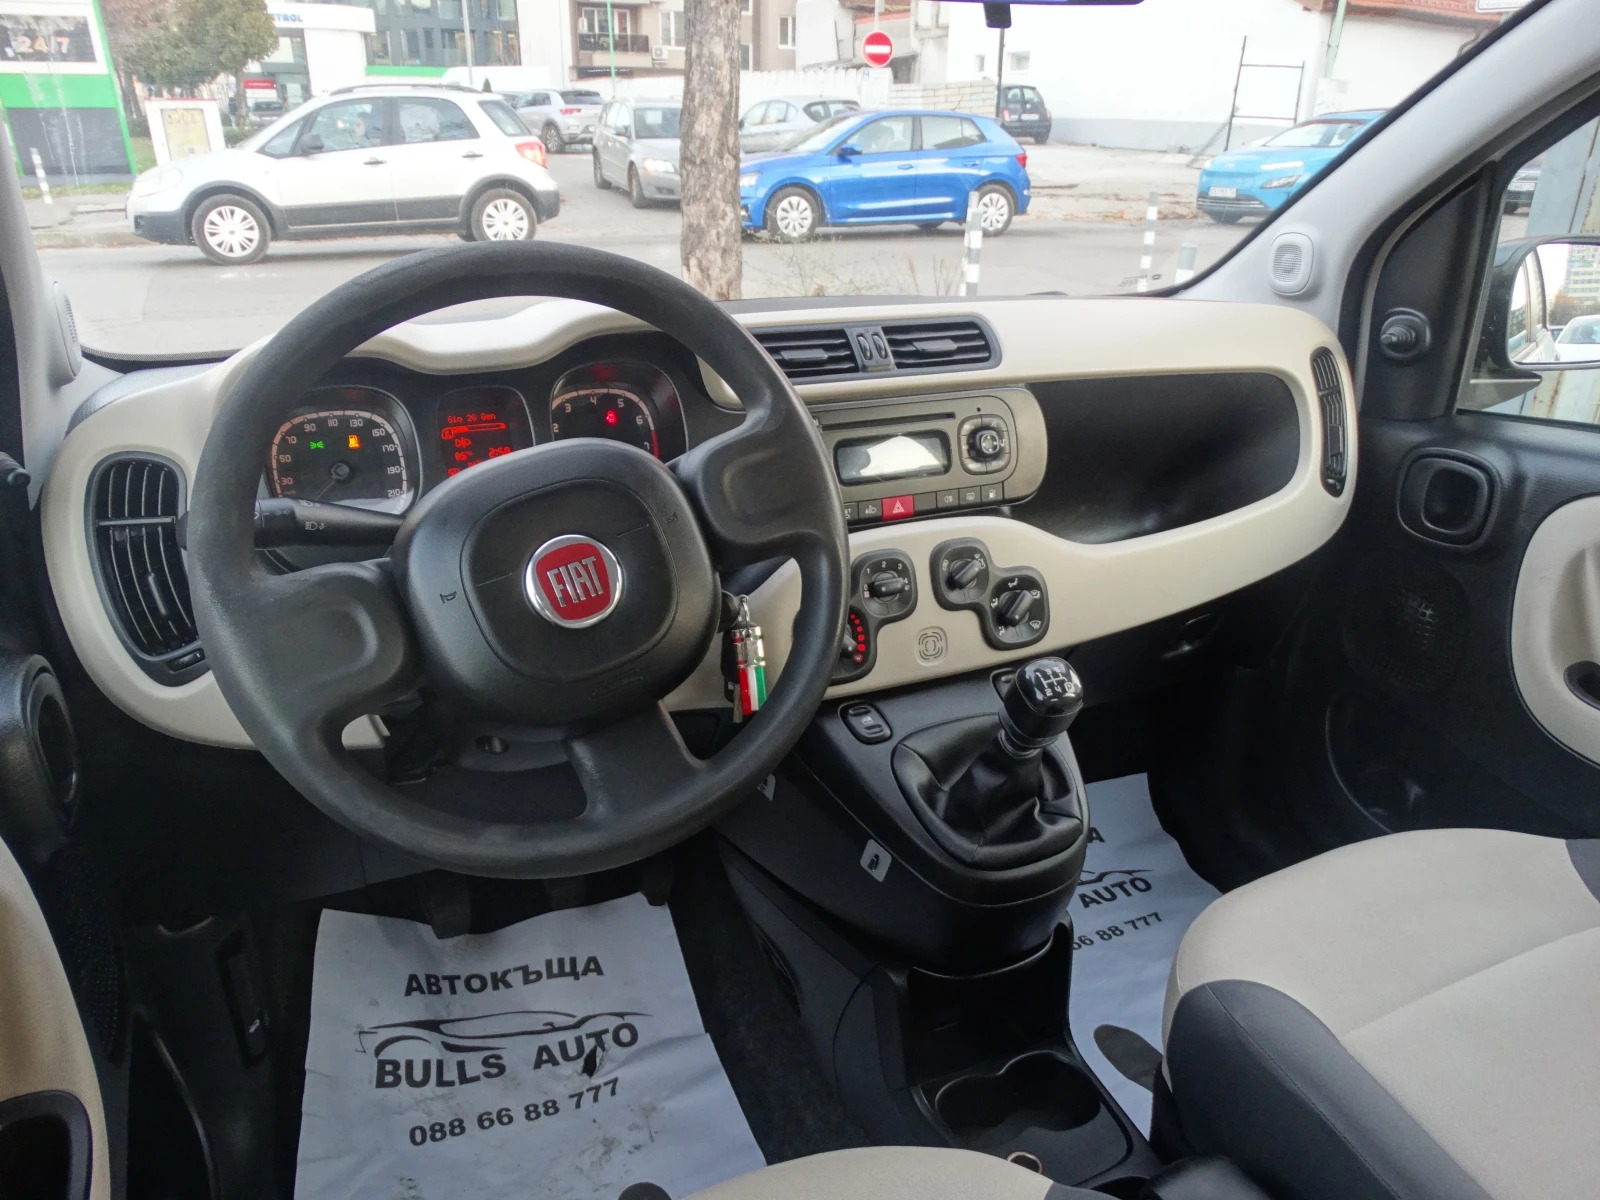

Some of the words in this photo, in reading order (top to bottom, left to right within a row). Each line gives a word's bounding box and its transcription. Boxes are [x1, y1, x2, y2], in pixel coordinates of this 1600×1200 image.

[590, 396, 597, 405] 4
[617, 399, 624, 408] 5
[565, 403, 571, 412] 3
[327, 419, 338, 427] 110
[350, 419, 363, 427] 130
[636, 415, 643, 424] 6
[304, 423, 316, 431] 90
[552, 423, 559, 432] 2
[372, 428, 386, 437] 150
[285, 436, 297, 444] 70
[382, 444, 395, 452] 170
[387, 466, 400, 474] 190
[387, 489, 401, 497] 210
[546, 556, 604, 608] FIAT
[1044, 688, 1053, 697] 2
[1054, 685, 1062, 693] 4
[1078, 877, 1152, 908] AUTO
[1095, 925, 1124, 941] 88
[1123, 912, 1163, 930] 777
[404, 956, 604, 996] АВТОКЪЩА
[375, 1054, 507, 1089] BULLS
[533, 1022, 639, 1070] AUTO
[409, 1118, 466, 1147] 088
[476, 1107, 514, 1131] 66
[523, 1099, 560, 1122] 88
[568, 1077, 619, 1110] 777
